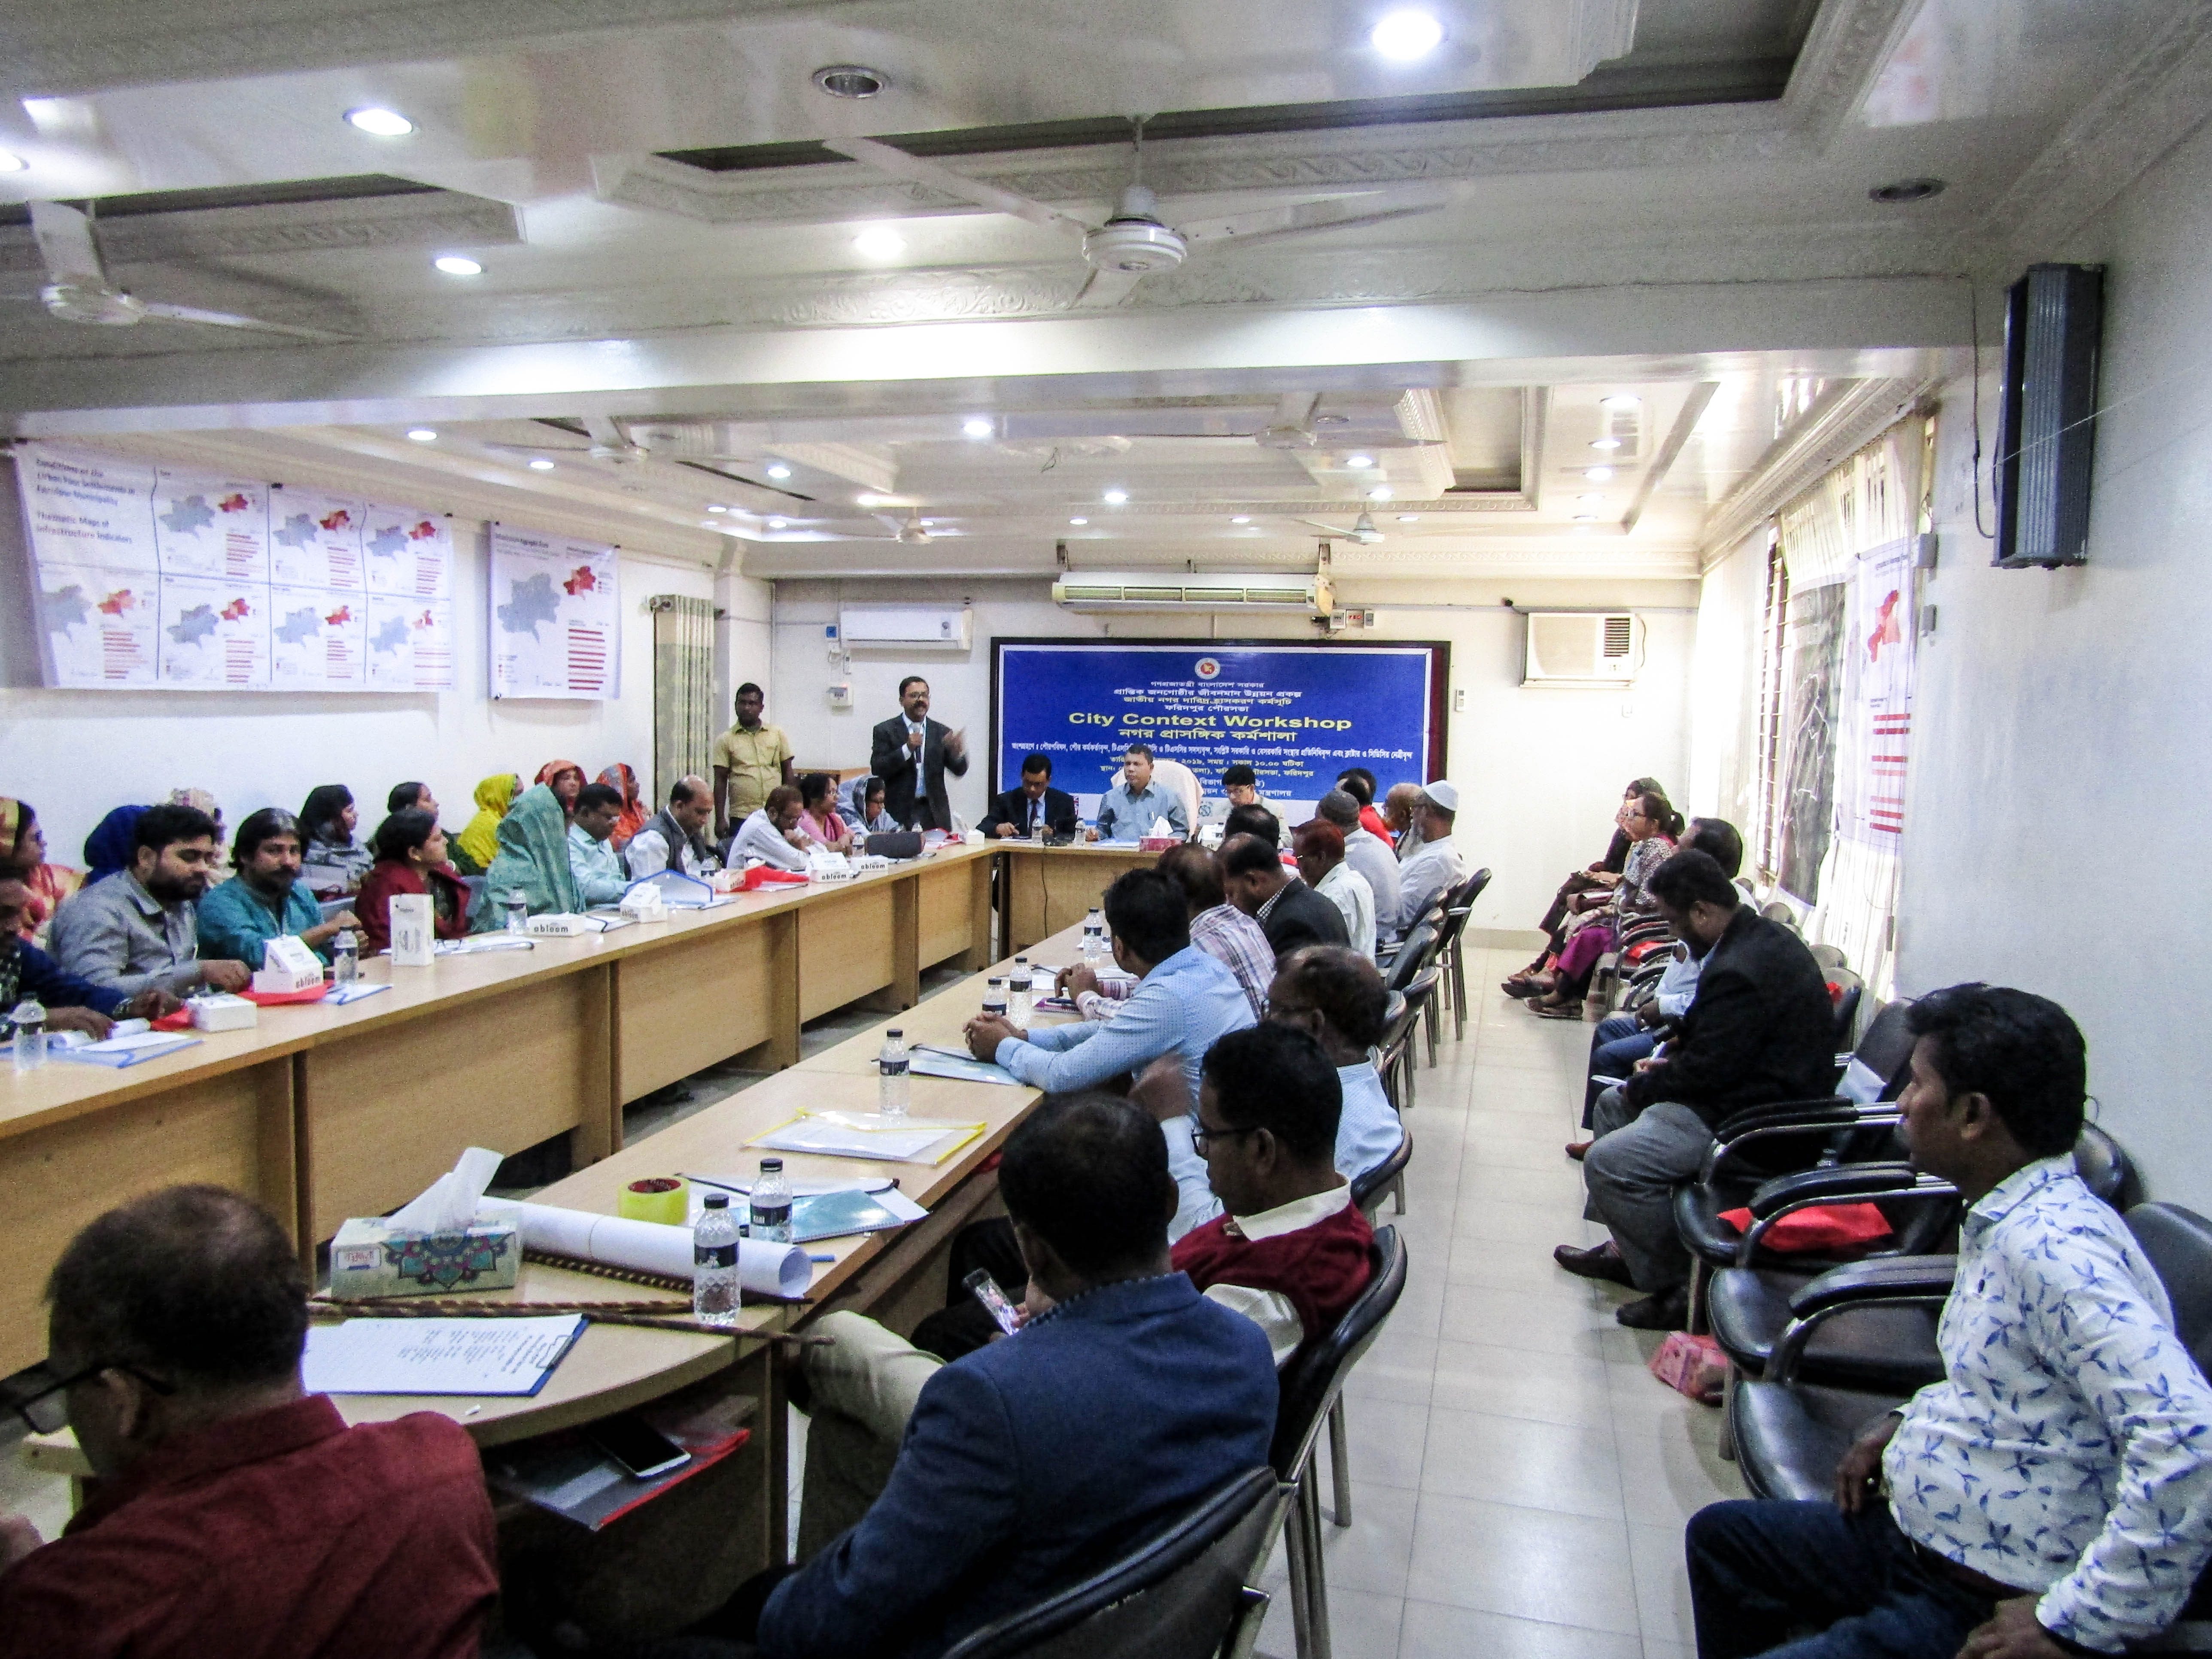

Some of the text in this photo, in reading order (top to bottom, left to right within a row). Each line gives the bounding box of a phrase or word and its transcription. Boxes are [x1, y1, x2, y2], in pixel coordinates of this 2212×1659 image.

[1164, 703, 1205, 713] ফরিদপুর
[1069, 712, 1352, 731] City Context Workshop
[1118, 727, 1298, 742] নগর প্রাসঙ্গিক কর্মশালা
[534, 924, 568, 933] abloom
